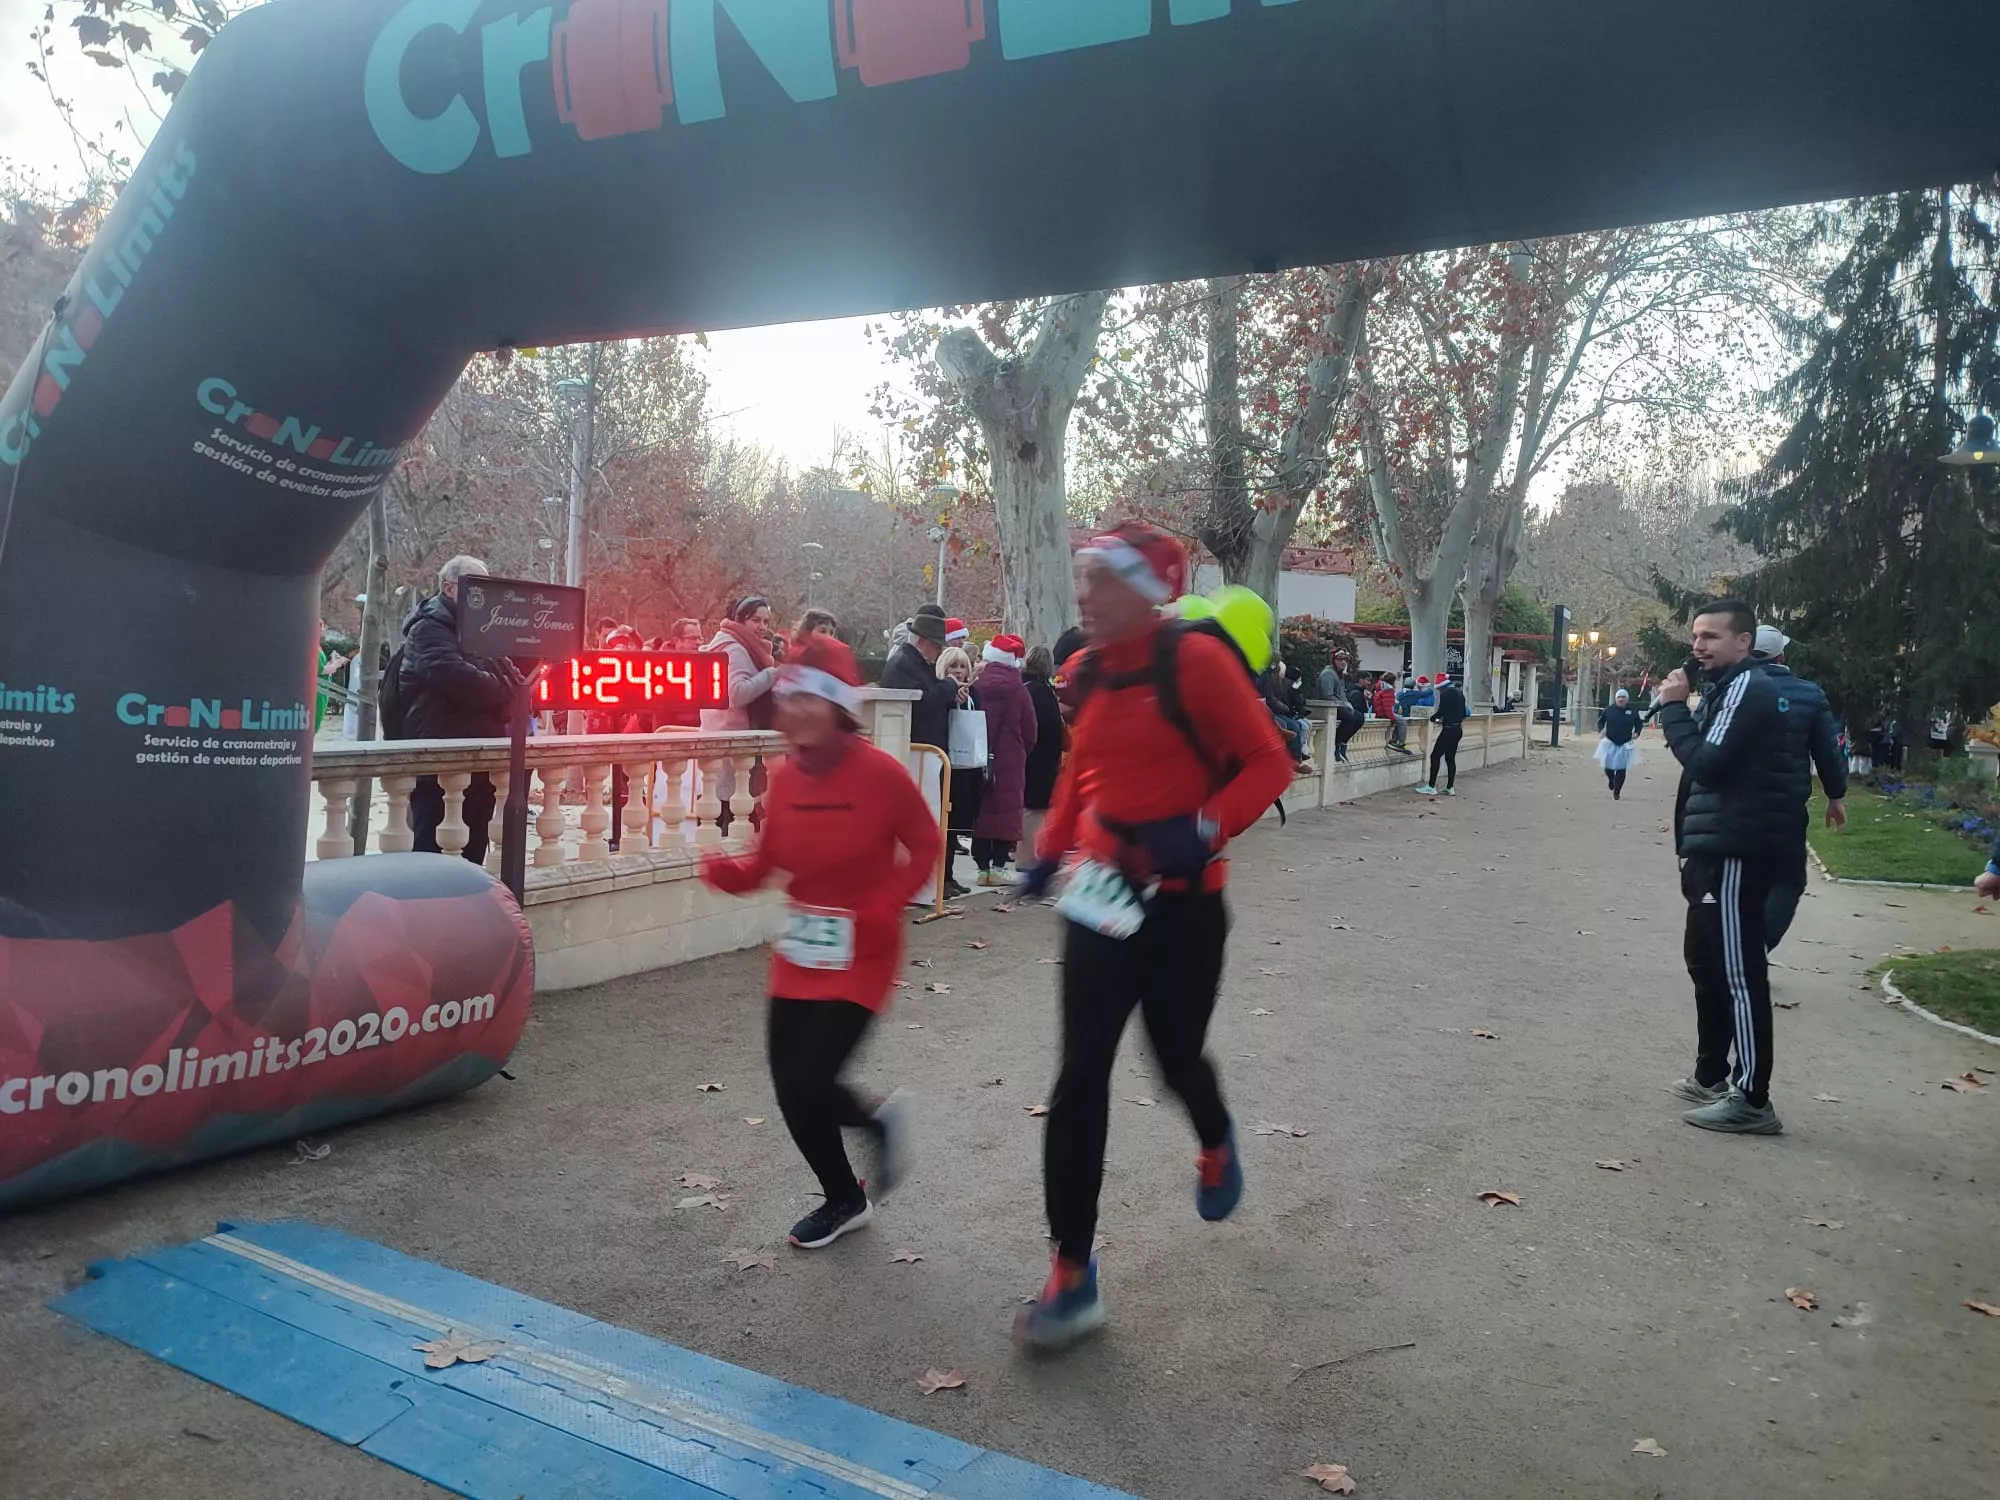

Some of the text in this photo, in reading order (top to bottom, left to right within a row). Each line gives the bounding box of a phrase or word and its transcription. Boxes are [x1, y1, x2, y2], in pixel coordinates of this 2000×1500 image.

[210, 428, 273, 464] Servicio
[276, 457, 297, 473] de
[192, 441, 254, 476] gestión
[255, 467, 277, 484] de
[279, 479, 330, 498] eventos
[480, 605, 575, 633] Javier Tomeo
[34, 722, 42, 733] y
[144, 734, 199, 749] Servicio
[202, 737, 220, 750] de
[291, 741, 297, 752] y
[136, 751, 189, 764] gestión
[193, 753, 210, 765] de
[213, 757, 257, 767] eventos
[0, 992, 495, 1115] cronolimits2020.com
